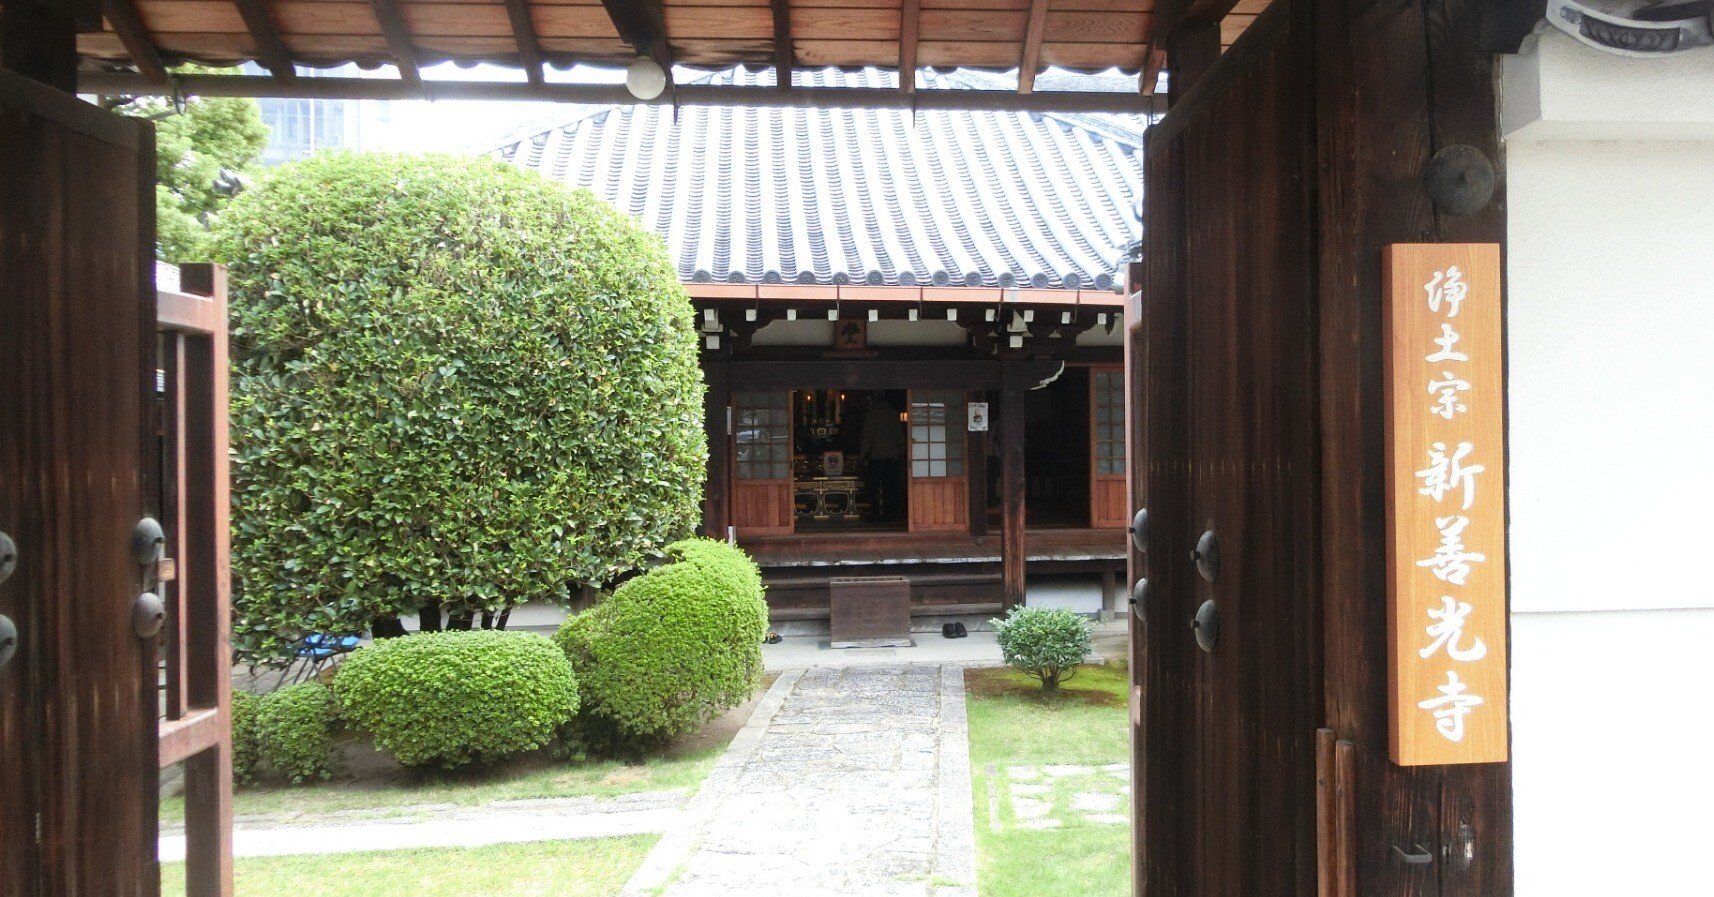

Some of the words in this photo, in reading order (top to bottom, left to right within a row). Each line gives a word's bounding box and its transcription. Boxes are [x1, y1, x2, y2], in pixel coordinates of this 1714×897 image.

[1424, 265, 1471, 420] 浄土宗
[1415, 441, 1488, 744] 新善光寺
